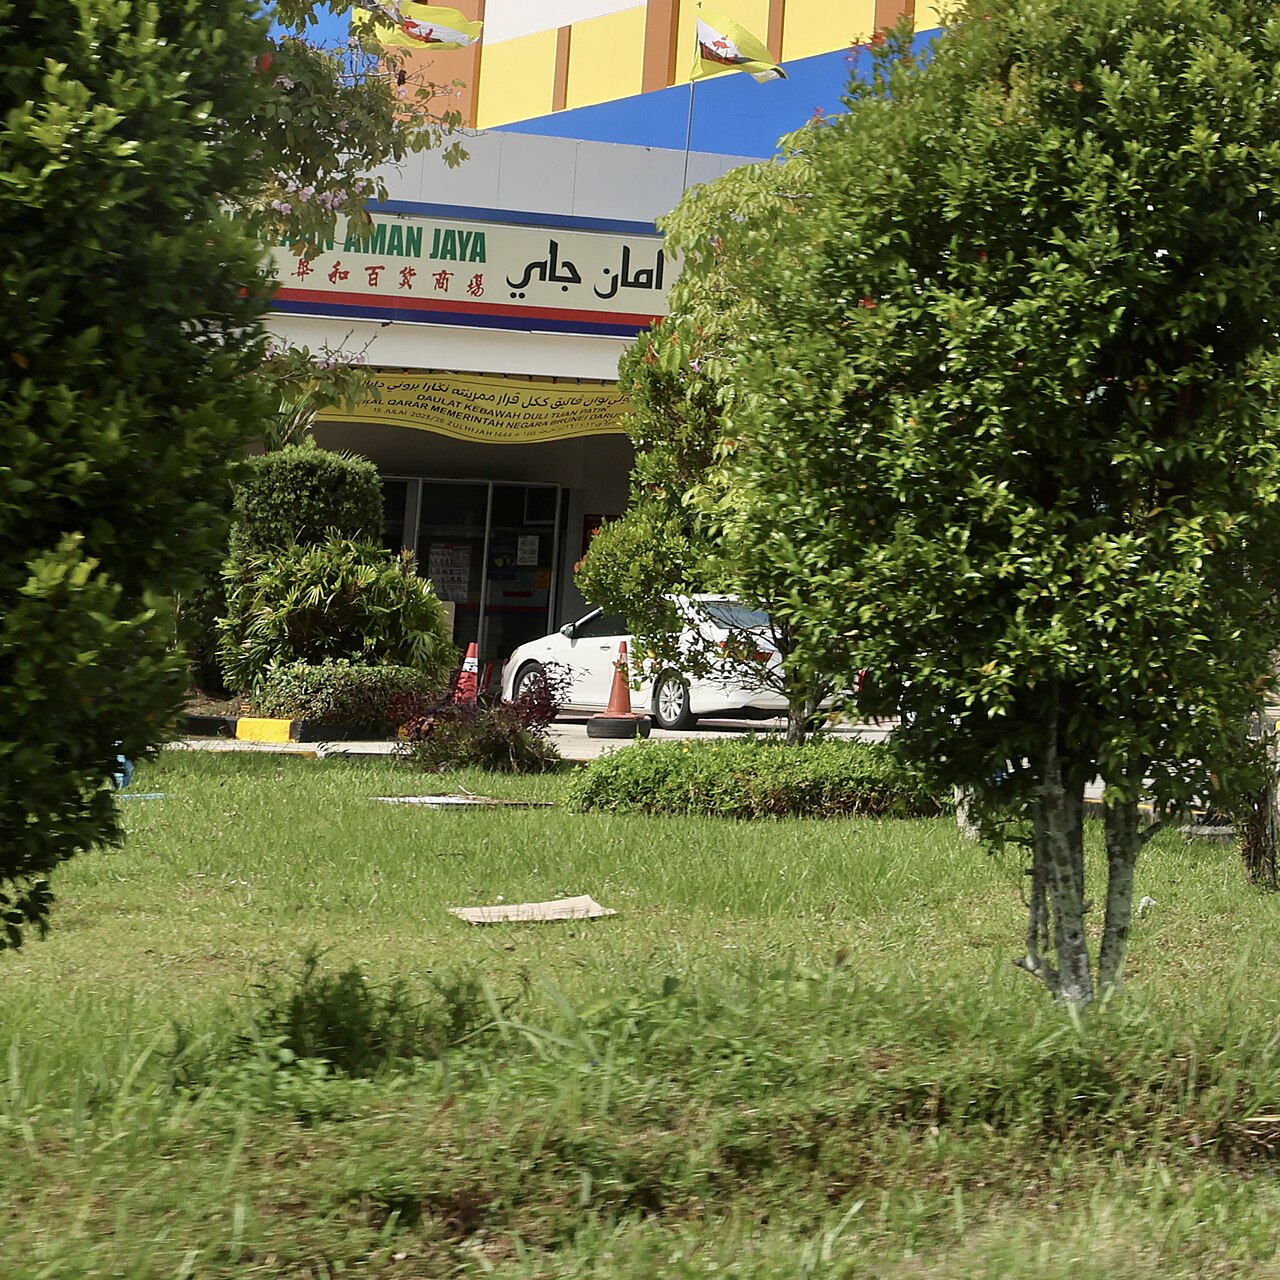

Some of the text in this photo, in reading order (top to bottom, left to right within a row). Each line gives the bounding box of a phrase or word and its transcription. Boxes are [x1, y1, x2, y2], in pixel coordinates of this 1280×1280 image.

[343, 223, 423, 258] AMAN
[429, 228, 487, 264] JAYA
[506, 238, 665, 299] امان جاي
[387, 381, 419, 392] بروني
[387, 400, 429, 410] QARAR
[430, 405, 504, 427] MEMERINTAH
[506, 421, 548, 429] NEGARA
[550, 415, 588, 426] BRUNEI
[417, 394, 607, 420] DAULAT KEBAWAH DULI TUAN PATIK
[447, 421, 493, 436] ZULHIJAH
